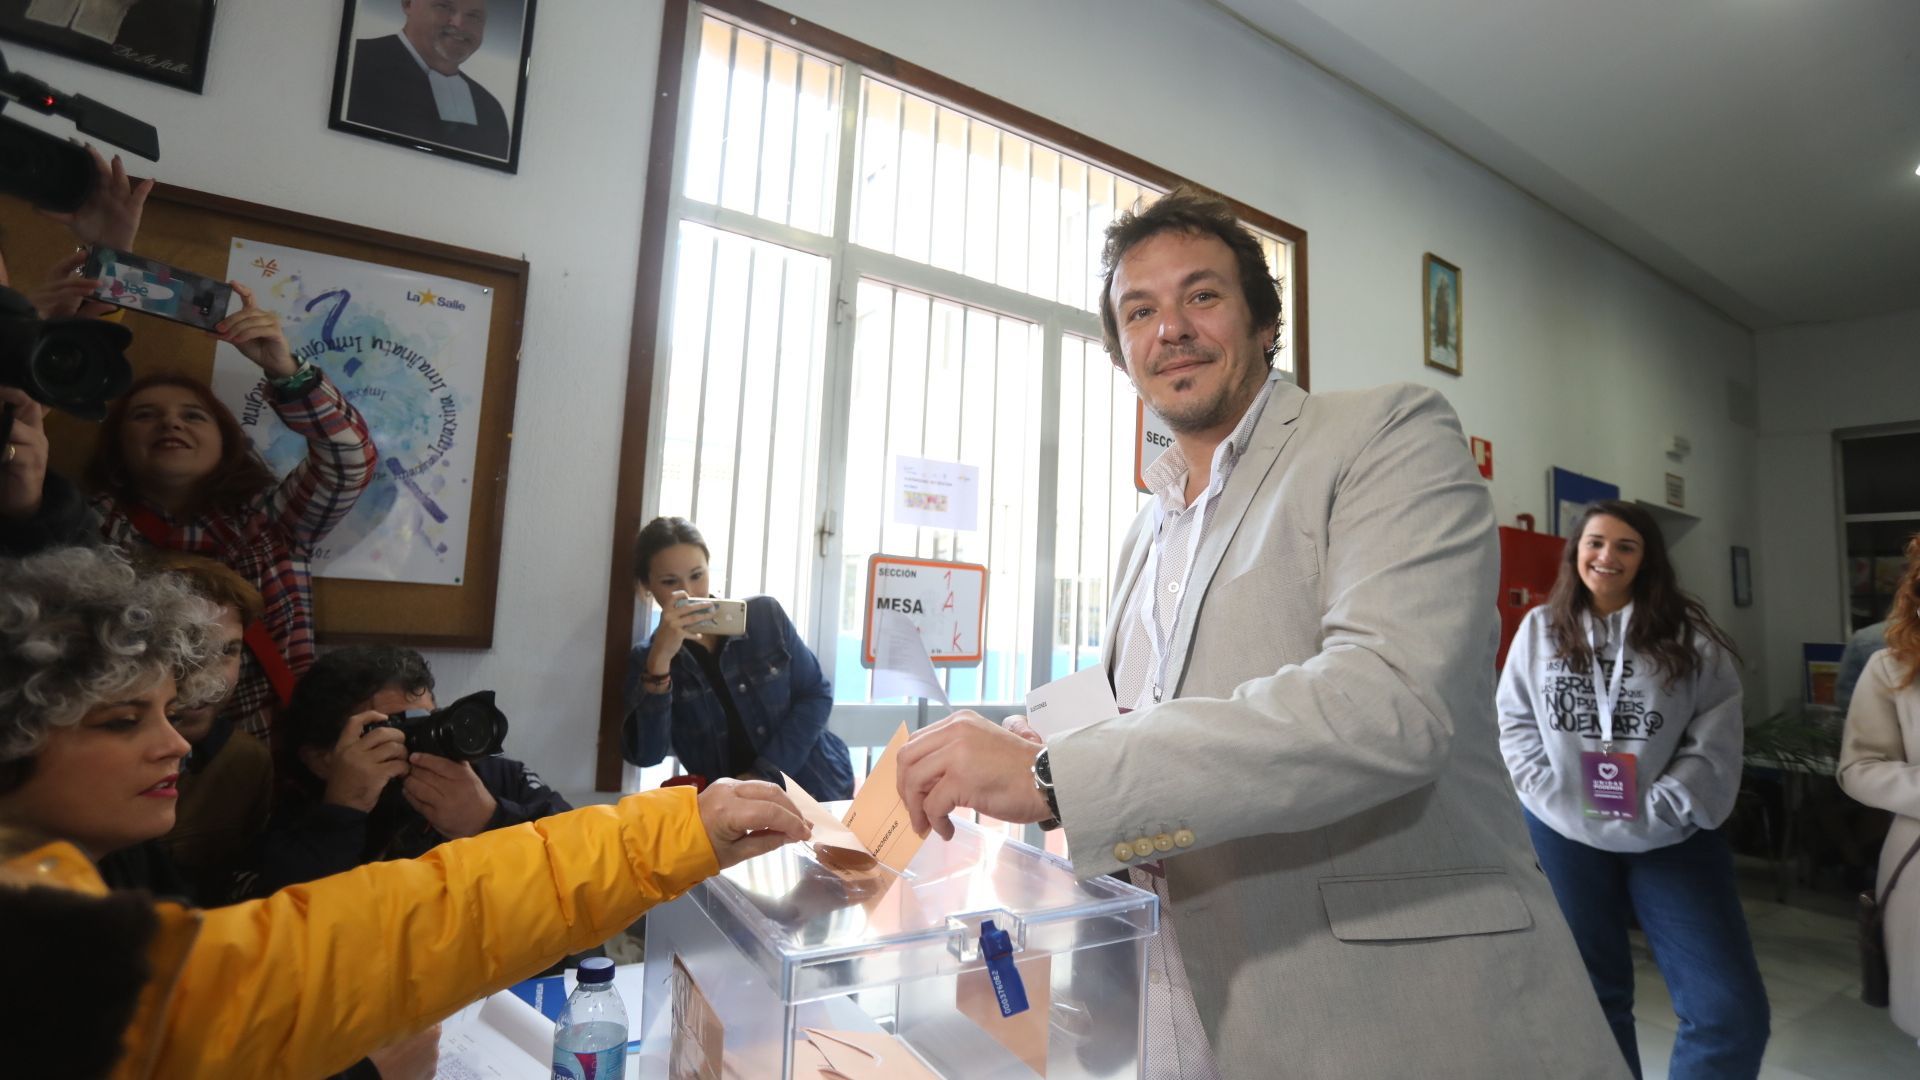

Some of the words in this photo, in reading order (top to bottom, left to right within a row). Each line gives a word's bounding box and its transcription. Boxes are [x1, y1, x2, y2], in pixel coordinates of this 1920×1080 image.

[406, 290, 420, 303] La
[437, 296, 466, 312] Salle
[878, 567, 917, 578] SECCIÓN
[876, 597, 924, 614] MESA
[942, 591, 954, 613] A
[1545, 692, 1576, 713] NO
